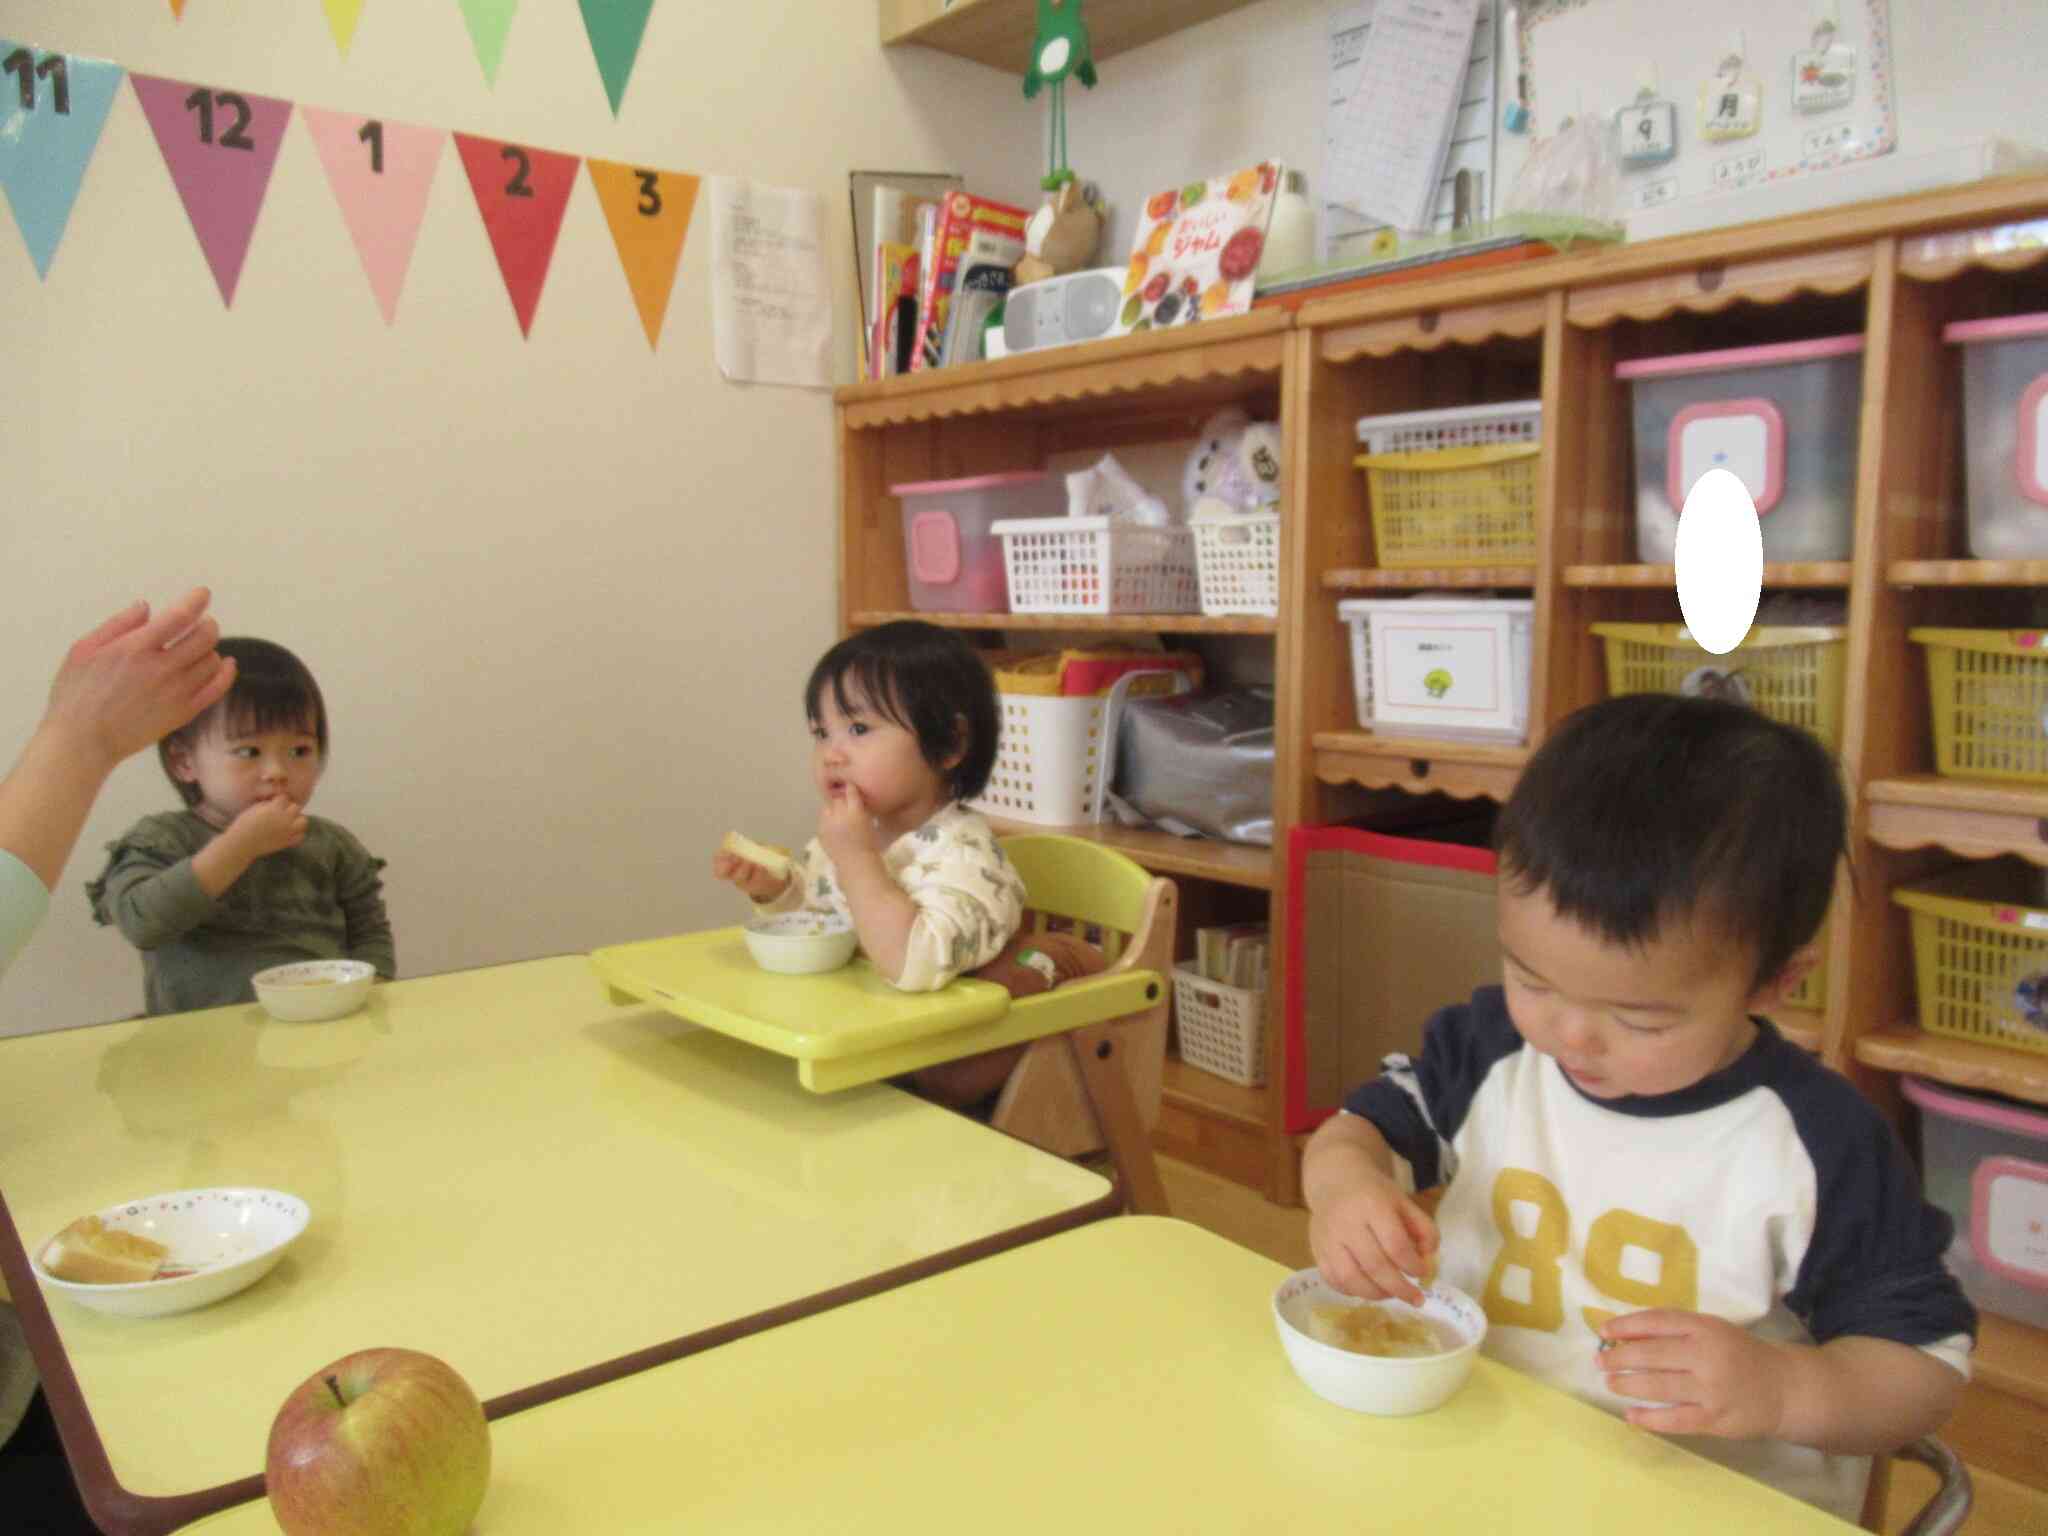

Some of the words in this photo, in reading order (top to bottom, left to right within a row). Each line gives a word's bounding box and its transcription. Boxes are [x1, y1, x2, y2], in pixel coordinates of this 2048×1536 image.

[3, 48, 70, 115] 11
[185, 88, 255, 152] 12
[358, 120, 384, 174] 1
[1637, 119, 1652, 141] 9
[501, 146, 535, 199] 2
[634, 169, 662, 217] 3
[1480, 1167, 1698, 1336] 89
